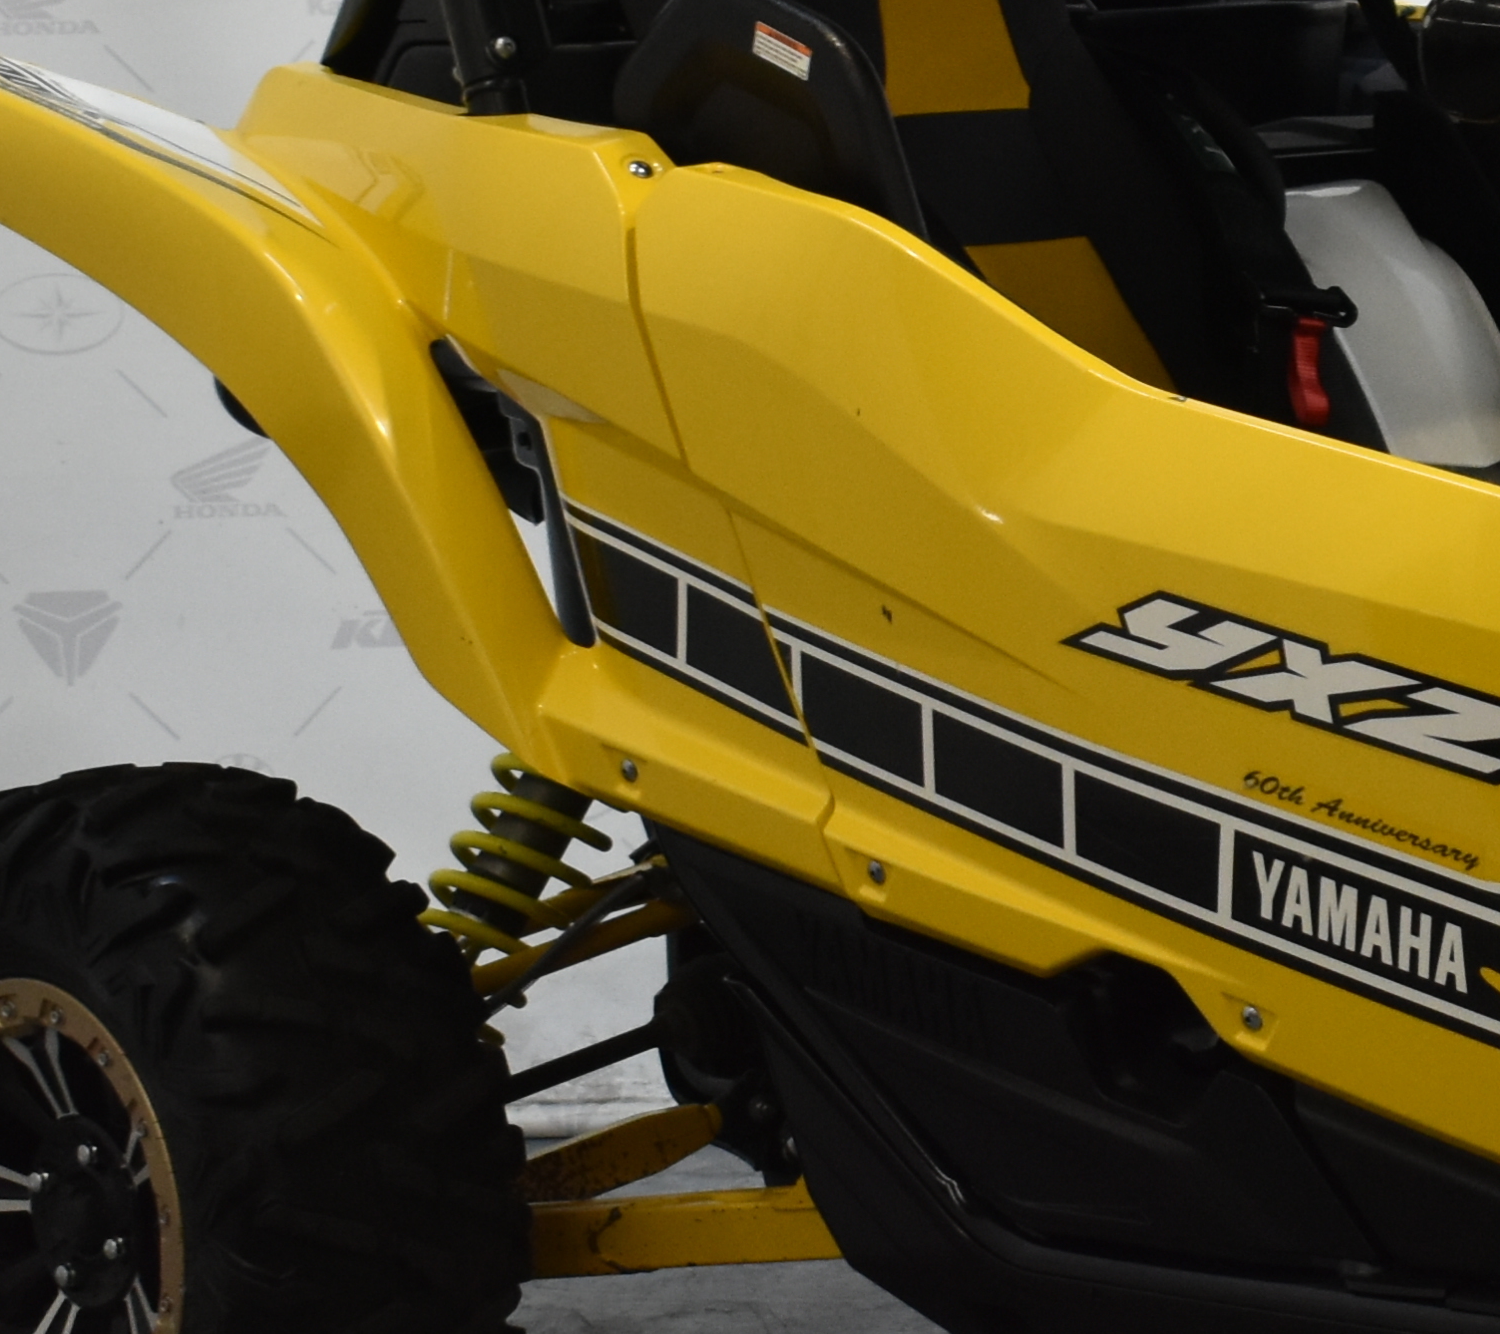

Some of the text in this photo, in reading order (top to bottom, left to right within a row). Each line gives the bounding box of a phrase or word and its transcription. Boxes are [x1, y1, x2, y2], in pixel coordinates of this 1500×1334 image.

[172, 503, 286, 520] HONDA
[1242, 769, 1481, 870] 60th Anniversary
[1251, 850, 1468, 995] YAMAHA
